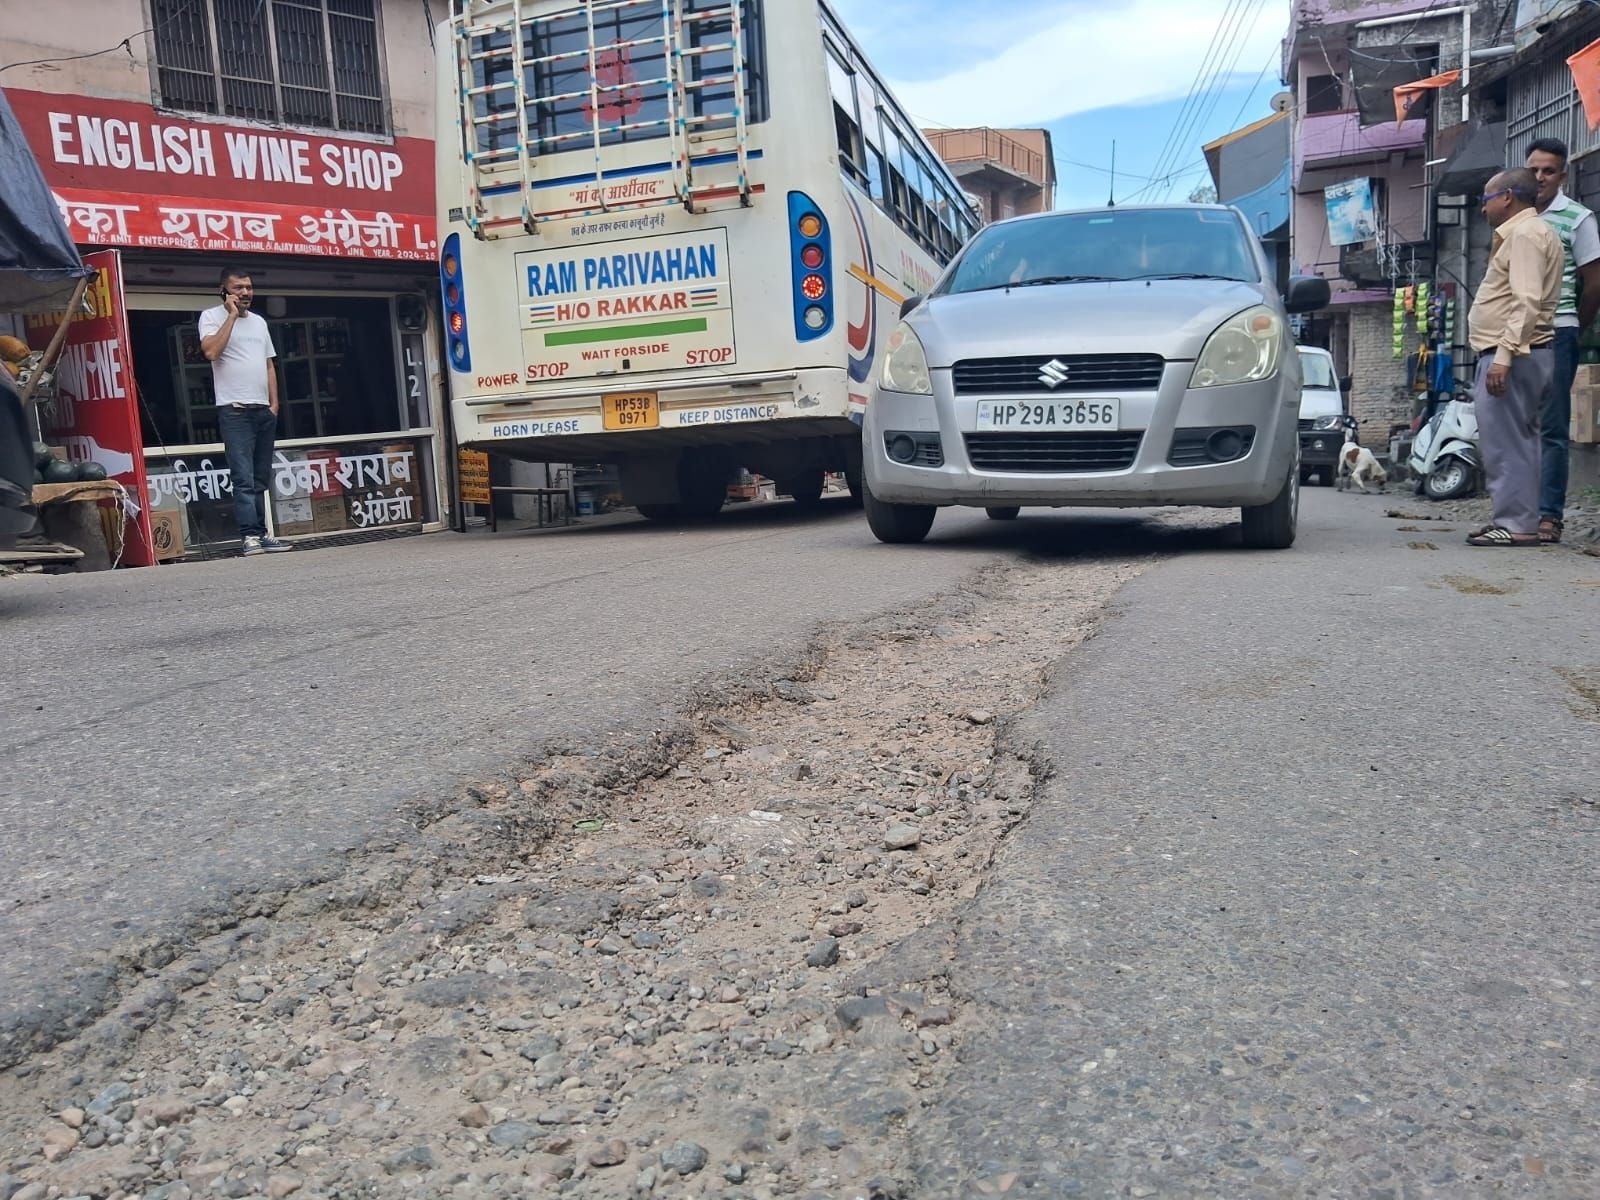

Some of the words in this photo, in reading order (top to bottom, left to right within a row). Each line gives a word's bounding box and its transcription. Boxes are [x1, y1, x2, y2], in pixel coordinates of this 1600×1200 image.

[48, 112, 216, 178] ENGLISH
[225, 132, 313, 185] WINE
[319, 143, 403, 192] SHOP
[159, 207, 281, 240] शराब
[295, 209, 403, 248] अंग्रेजी
[110, 234, 132, 243] AMIT
[527, 260, 577, 297] RAM
[584, 243, 716, 291] PARIVAHAN
[557, 301, 591, 321] H/O
[597, 291, 688, 317] RAKKAR
[581, 350, 611, 360] WAIT
[614, 343, 670, 358] FORSIDE
[686, 347, 732, 365] STOP
[527, 362, 569, 378] STOP
[478, 373, 519, 388] POWER
[615, 398, 650, 411] HP53B
[619, 411, 647, 425] 0971
[679, 411, 709, 424] KEEP
[714, 406, 774, 422] DISTANCE
[493, 422, 528, 437] HORN
[532, 420, 579, 434] PLEASE
[272, 452, 329, 496] ठेका
[335, 451, 413, 489] शराब
